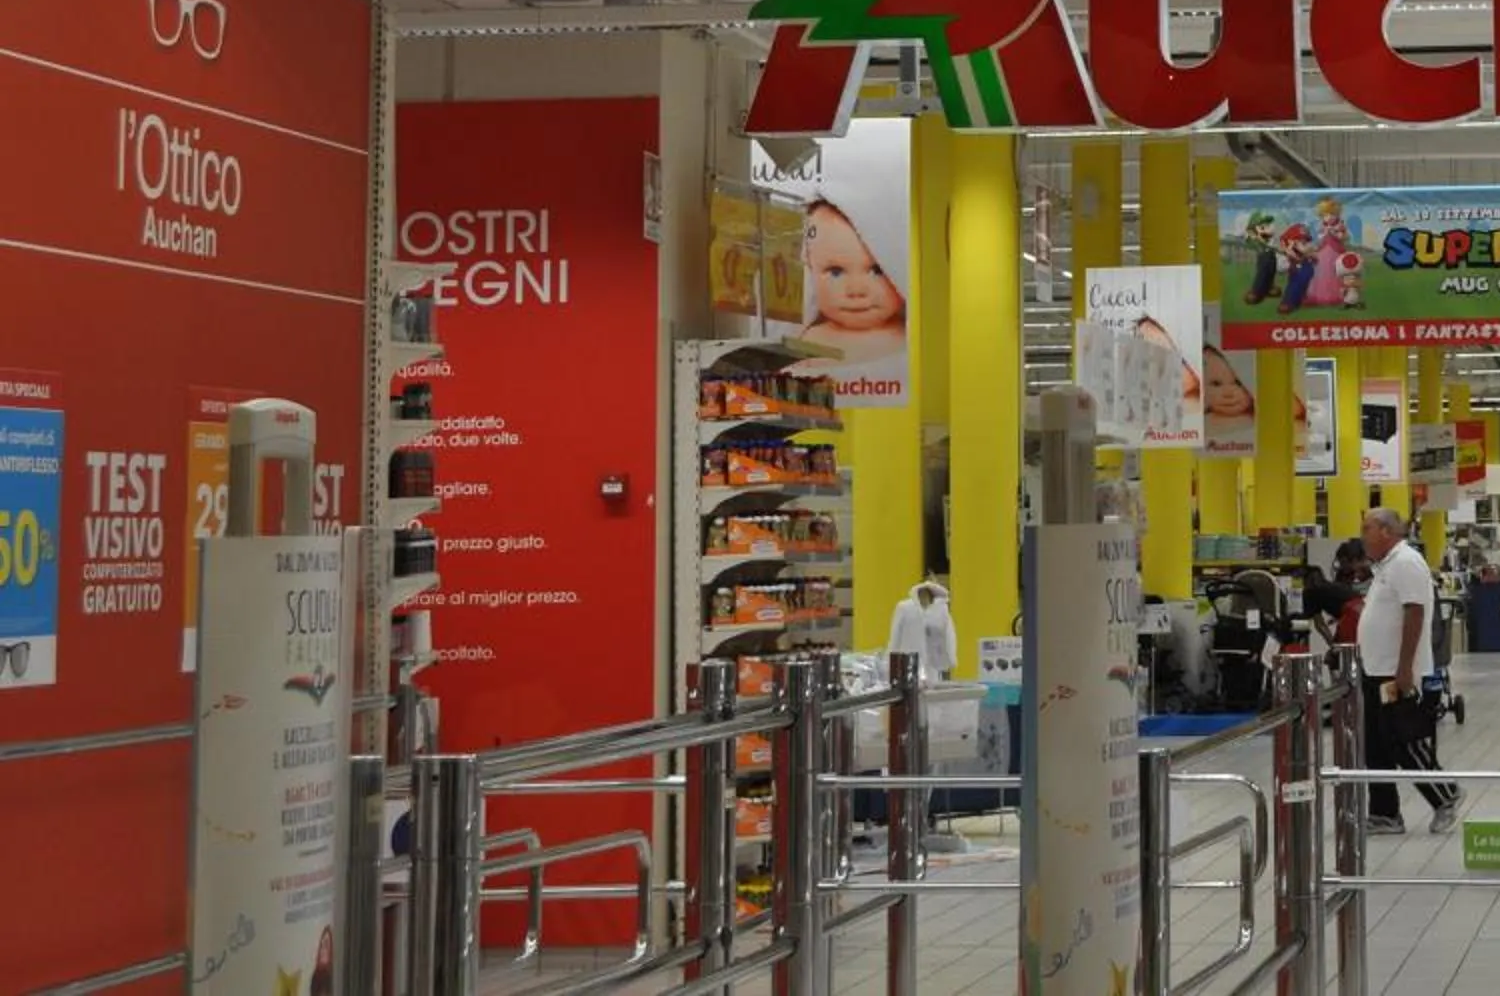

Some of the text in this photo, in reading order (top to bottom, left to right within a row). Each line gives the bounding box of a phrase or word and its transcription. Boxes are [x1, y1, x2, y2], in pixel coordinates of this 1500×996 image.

[117, 107, 241, 216] l'Ottico
[142, 207, 218, 257] Auchan
[401, 209, 549, 256] OSTRI
[432, 259, 569, 305] EGNI
[1439, 275, 1490, 293] MUG
[1271, 324, 1390, 342] COLLEZIONA
[834, 377, 902, 396] uchan
[441, 416, 505, 431] ddisfatto
[449, 434, 479, 447] due
[483, 431, 523, 446] volte.
[1206, 435, 1254, 451] Auchan
[86, 451, 166, 513] TEST
[313, 464, 344, 517] ST
[434, 482, 493, 497] agliare.
[85, 516, 164, 559] VISIVO
[443, 537, 493, 553] prezzo
[497, 535, 548, 553] giusto.
[83, 583, 162, 615] GRATUITO
[403, 589, 582, 608] prare al miglior prezzo.
